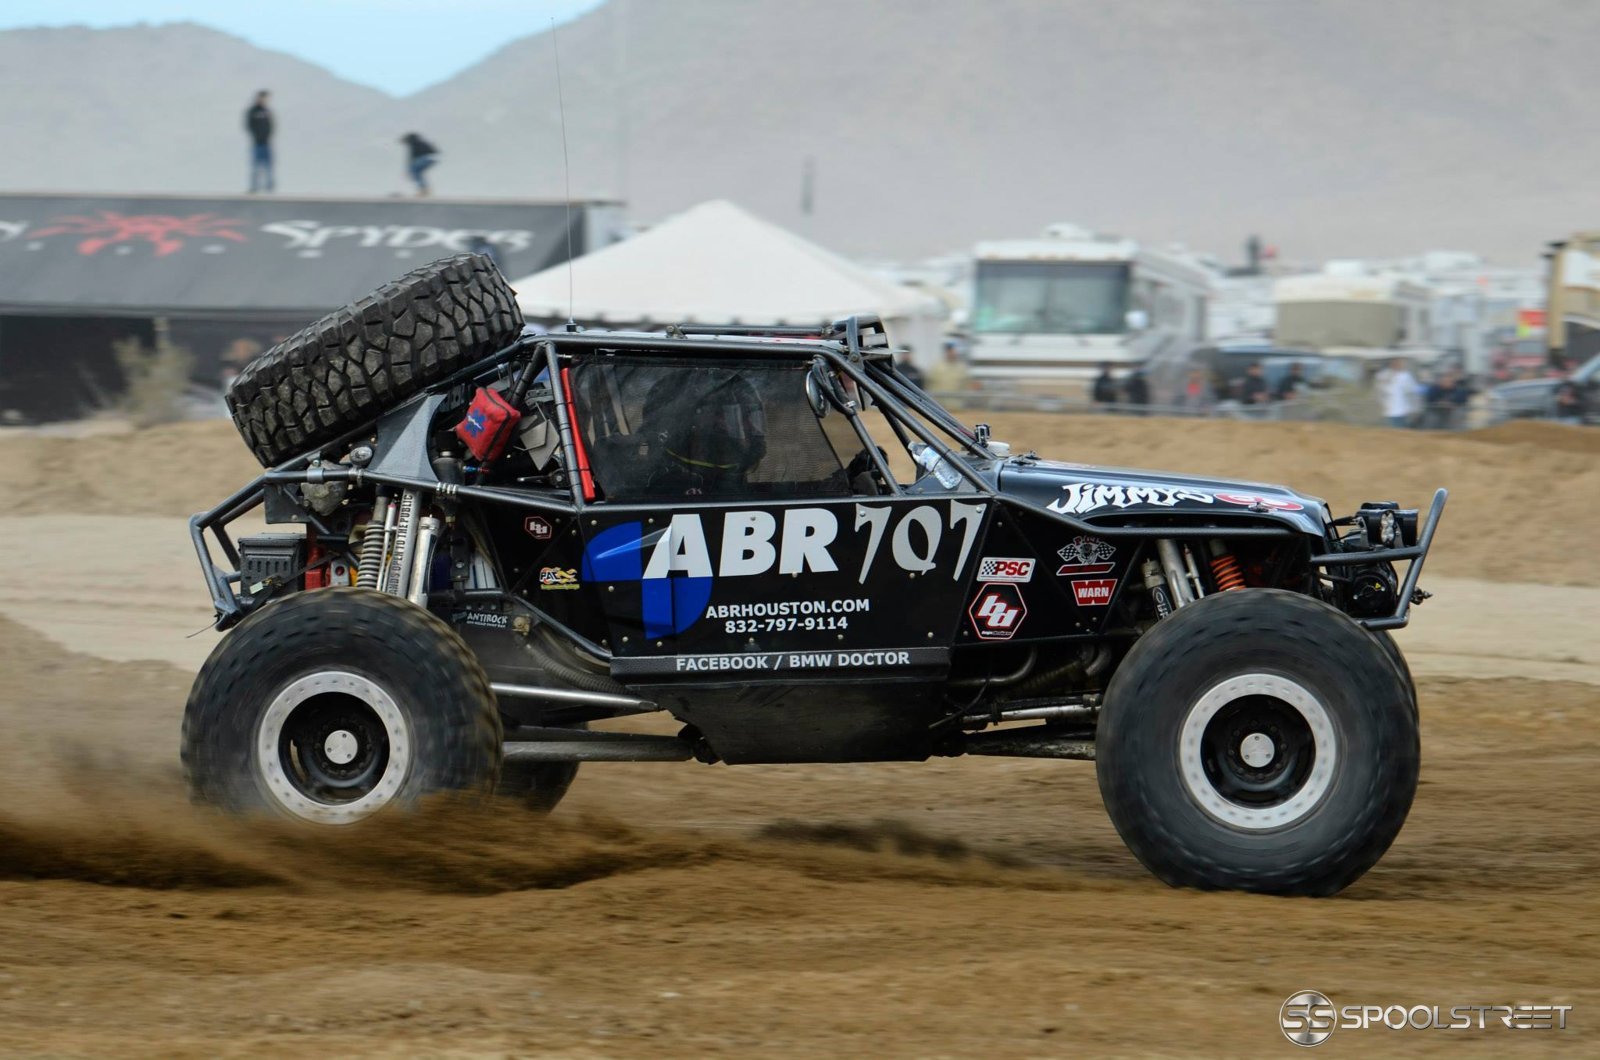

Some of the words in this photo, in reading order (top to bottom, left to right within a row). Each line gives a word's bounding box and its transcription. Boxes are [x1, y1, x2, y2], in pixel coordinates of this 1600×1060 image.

[400, 494, 414, 523] PUBLIC
[397, 524, 409, 540] THE
[396, 540, 406, 550] TO
[643, 508, 839, 579] ABR
[854, 499, 987, 584] 707
[993, 561, 1031, 576] PSC
[1078, 587, 1109, 599] WARN
[705, 599, 870, 619] ABRHOUSTON.COM
[467, 612, 508, 624] ANTIROCK
[725, 616, 848, 633] 832-797-9114
[676, 656, 768, 671] FACEBOOK
[789, 654, 833, 668] BMW
[838, 652, 910, 667] DOCTOR
